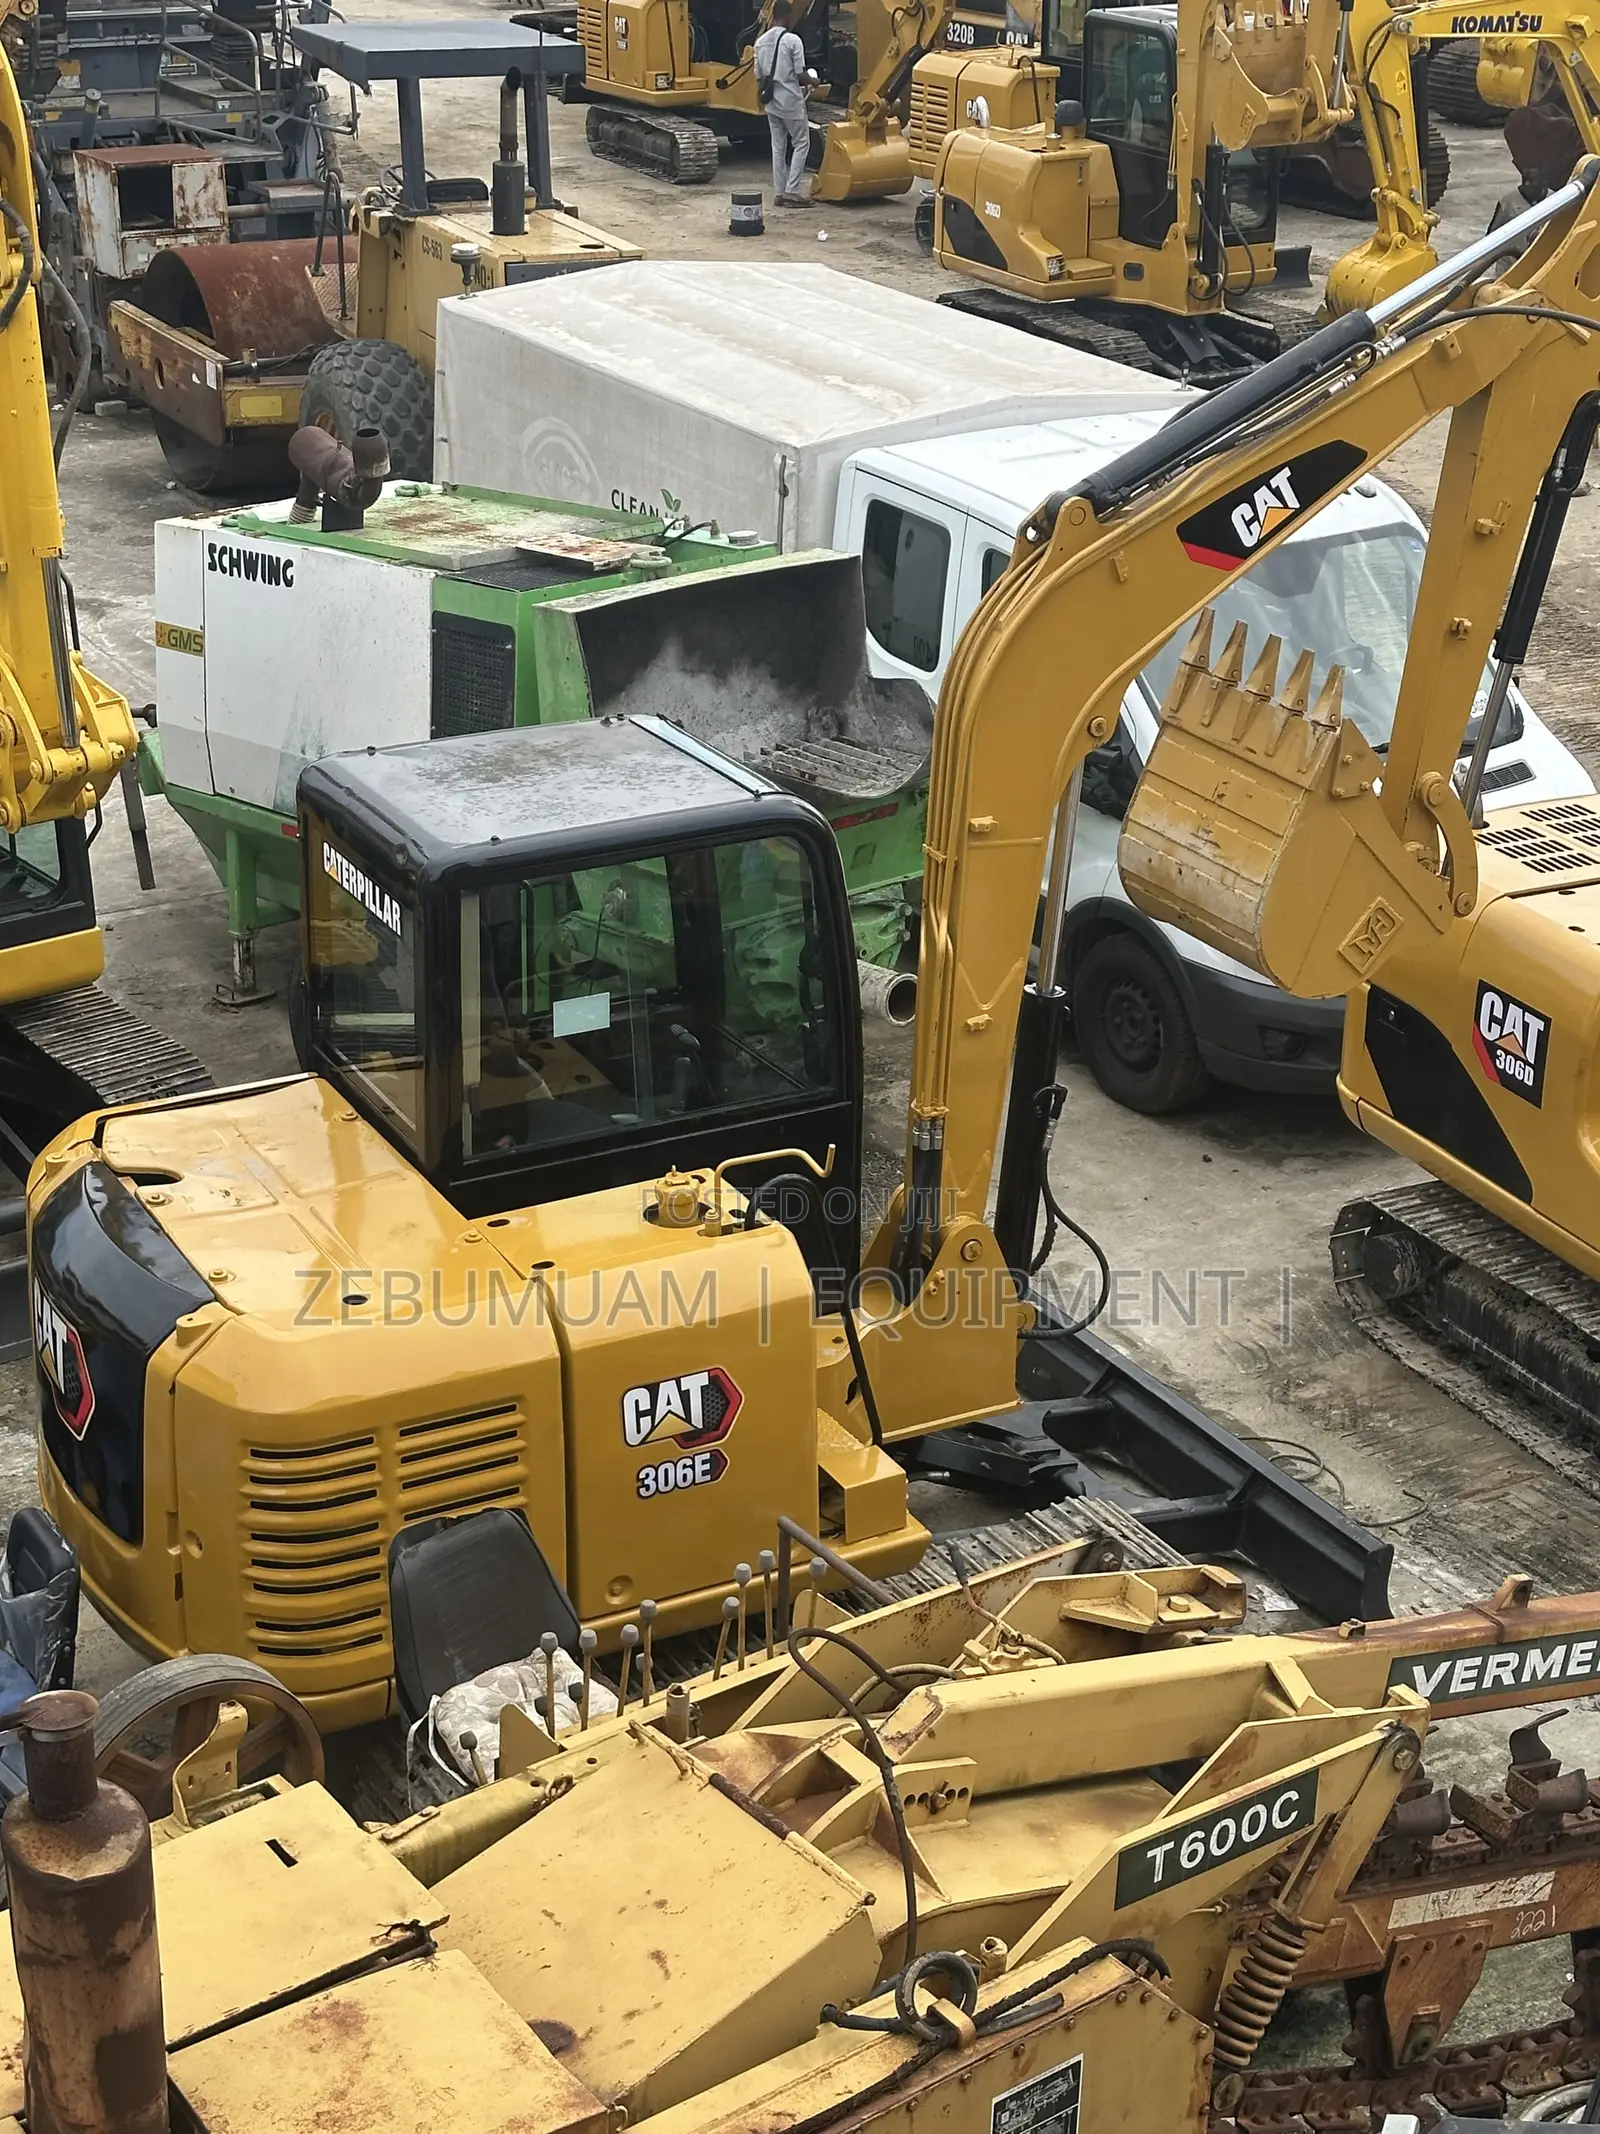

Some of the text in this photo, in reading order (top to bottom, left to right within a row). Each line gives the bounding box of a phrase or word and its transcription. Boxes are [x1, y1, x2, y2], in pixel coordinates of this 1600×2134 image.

[946, 22, 975, 45] 320B
[1451, 10, 1542, 33] KOMATSU
[1231, 466, 1300, 547] CAT
[207, 542, 294, 588] SCHWING
[167, 628, 204, 653] GMS
[323, 841, 402, 937] CATERPILLAR
[1480, 991, 1545, 1065] CAT
[1495, 1049, 1535, 1086] 306D
[34, 1276, 67, 1395] CAT
[623, 1371, 710, 1446] CAT
[639, 1452, 711, 1498] 306E
[1412, 1640, 1600, 1698] VERME
[1146, 1789, 1300, 1884] T600C
